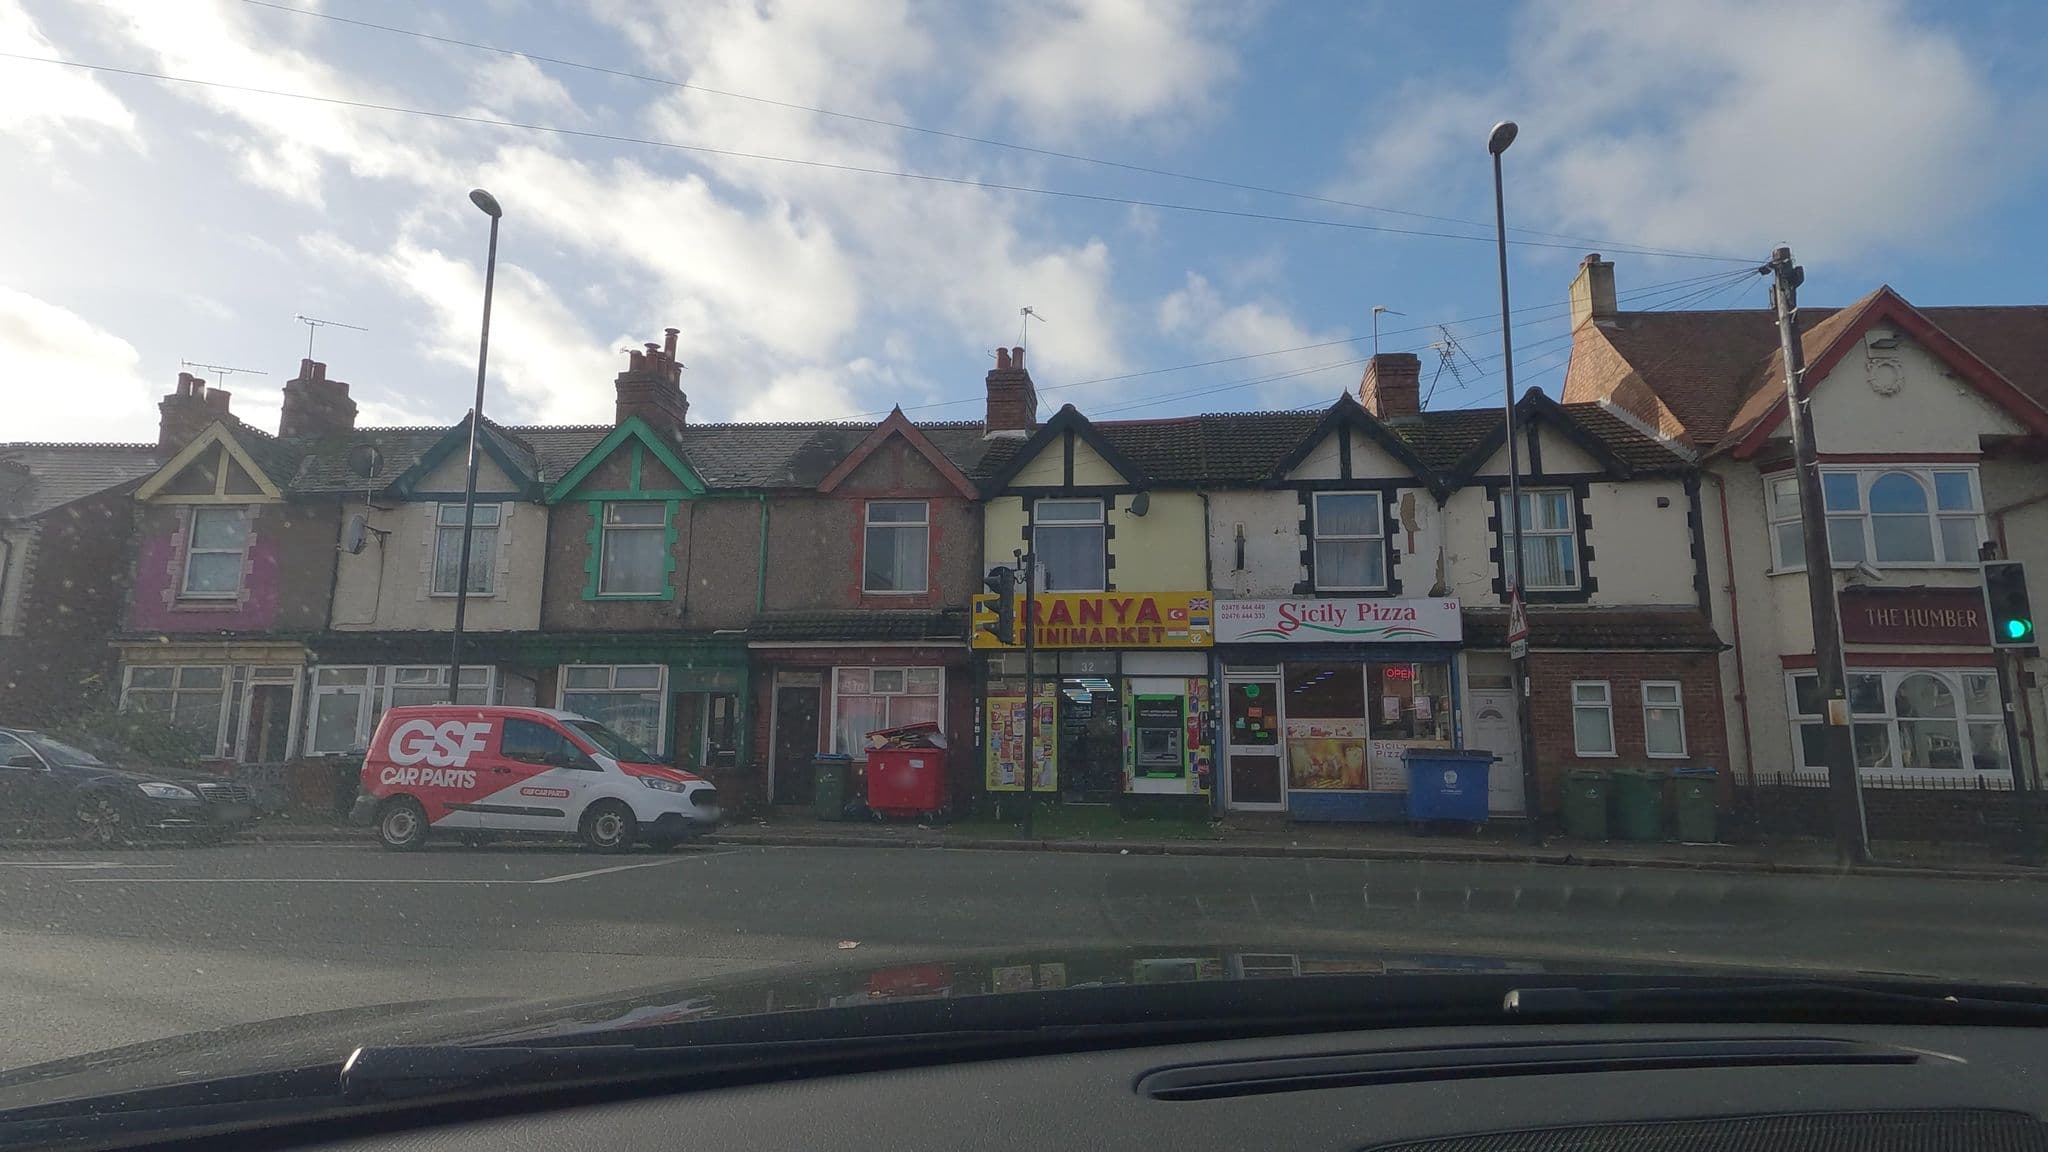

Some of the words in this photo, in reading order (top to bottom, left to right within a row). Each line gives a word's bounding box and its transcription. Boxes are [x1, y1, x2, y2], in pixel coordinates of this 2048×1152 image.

[1020, 597, 1162, 625] RANYA
[1443, 602, 1457, 610] 30
[1277, 602, 1348, 632] Sicily
[1356, 603, 1417, 622] Pizza
[1864, 608, 1899, 626] THE
[1903, 608, 1979, 628] HUMBER
[1190, 633, 1202, 644] 32
[1081, 662, 1095, 672] 32
[1386, 667, 1415, 679] OPEN
[388, 719, 493, 768] GSF
[1374, 741, 1408, 750] SICILY
[1376, 750, 1402, 758] PIZZ
[380, 766, 420, 786] CAR
[419, 768, 478, 789] PARTS
[534, 789, 547, 797] CAR
[547, 790, 568, 798] PARTS
